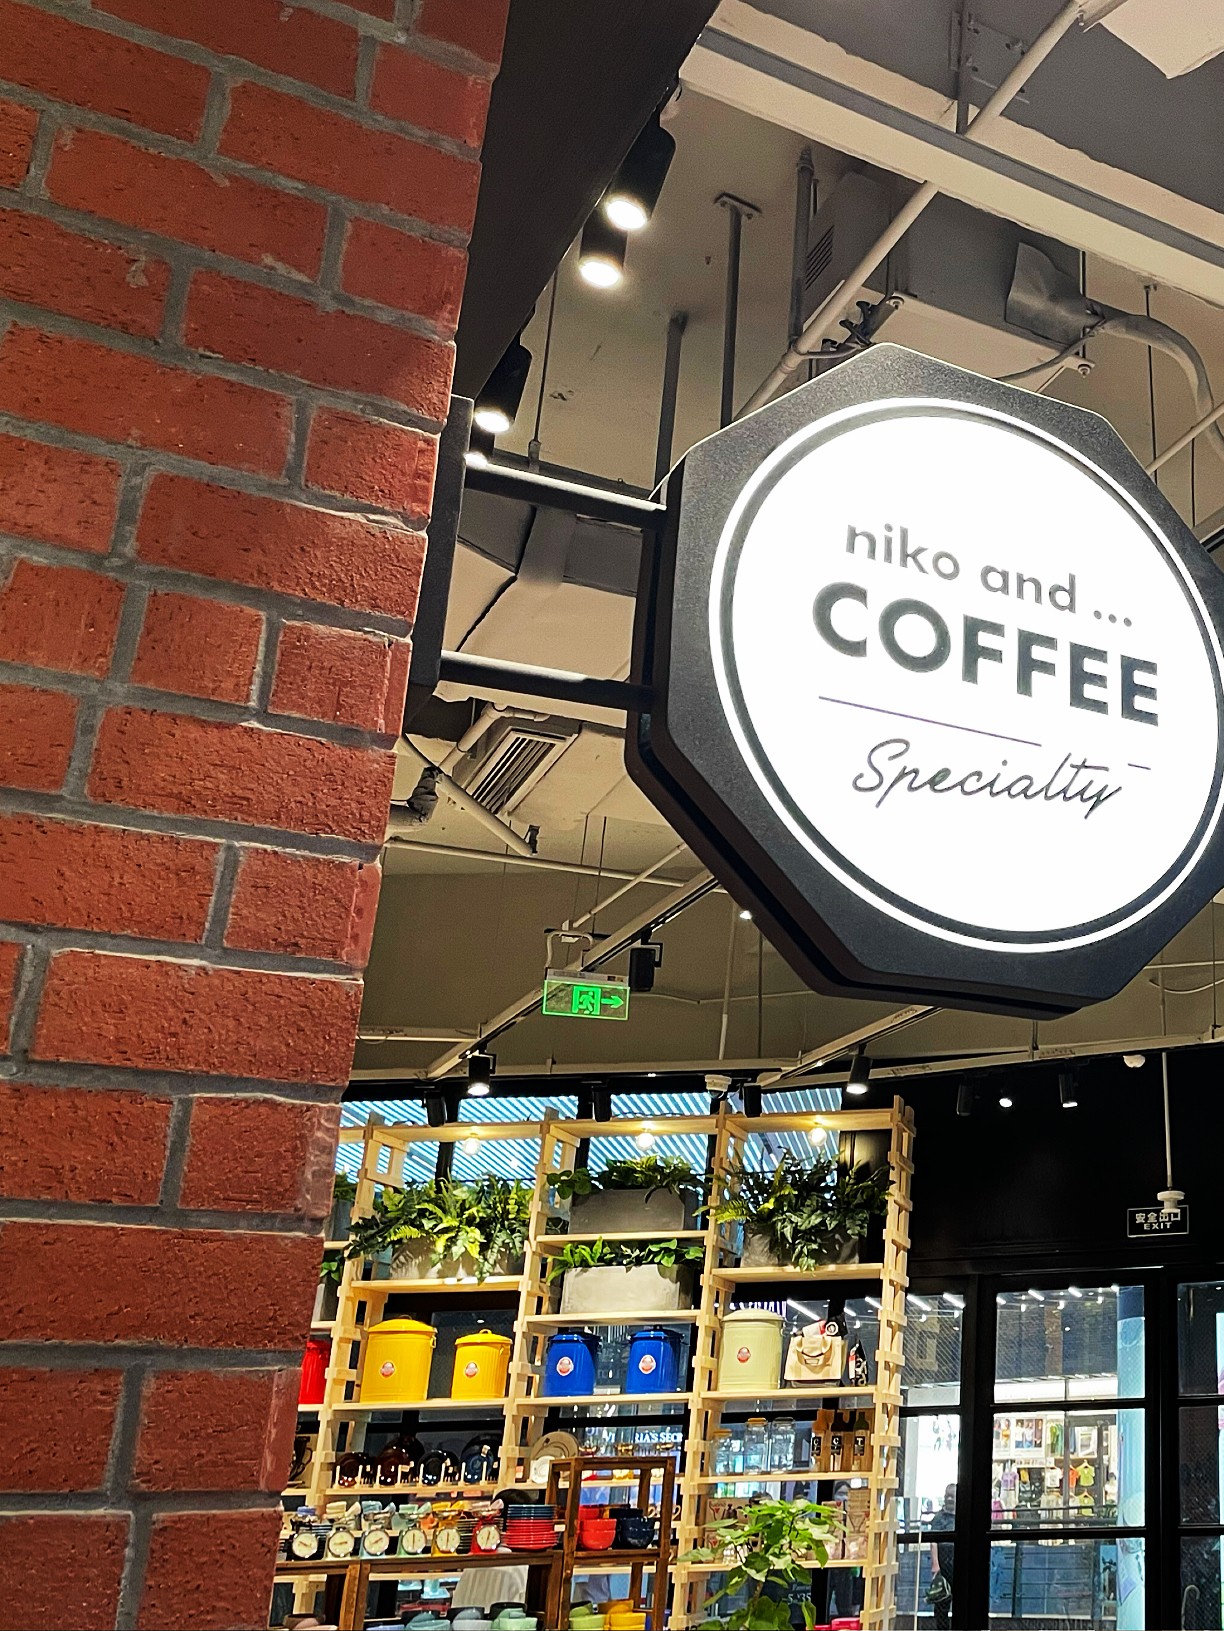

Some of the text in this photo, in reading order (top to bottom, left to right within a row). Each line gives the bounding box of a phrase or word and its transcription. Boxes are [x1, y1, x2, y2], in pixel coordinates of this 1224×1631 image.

[846, 523, 961, 581] niko
[980, 563, 1077, 614] and
[812, 581, 1160, 727] COFFEE
[852, 737, 1122, 819] Specialty
[1135, 1209, 1181, 1223] 安全出口
[1144, 1222, 1172, 1230] EXIT
